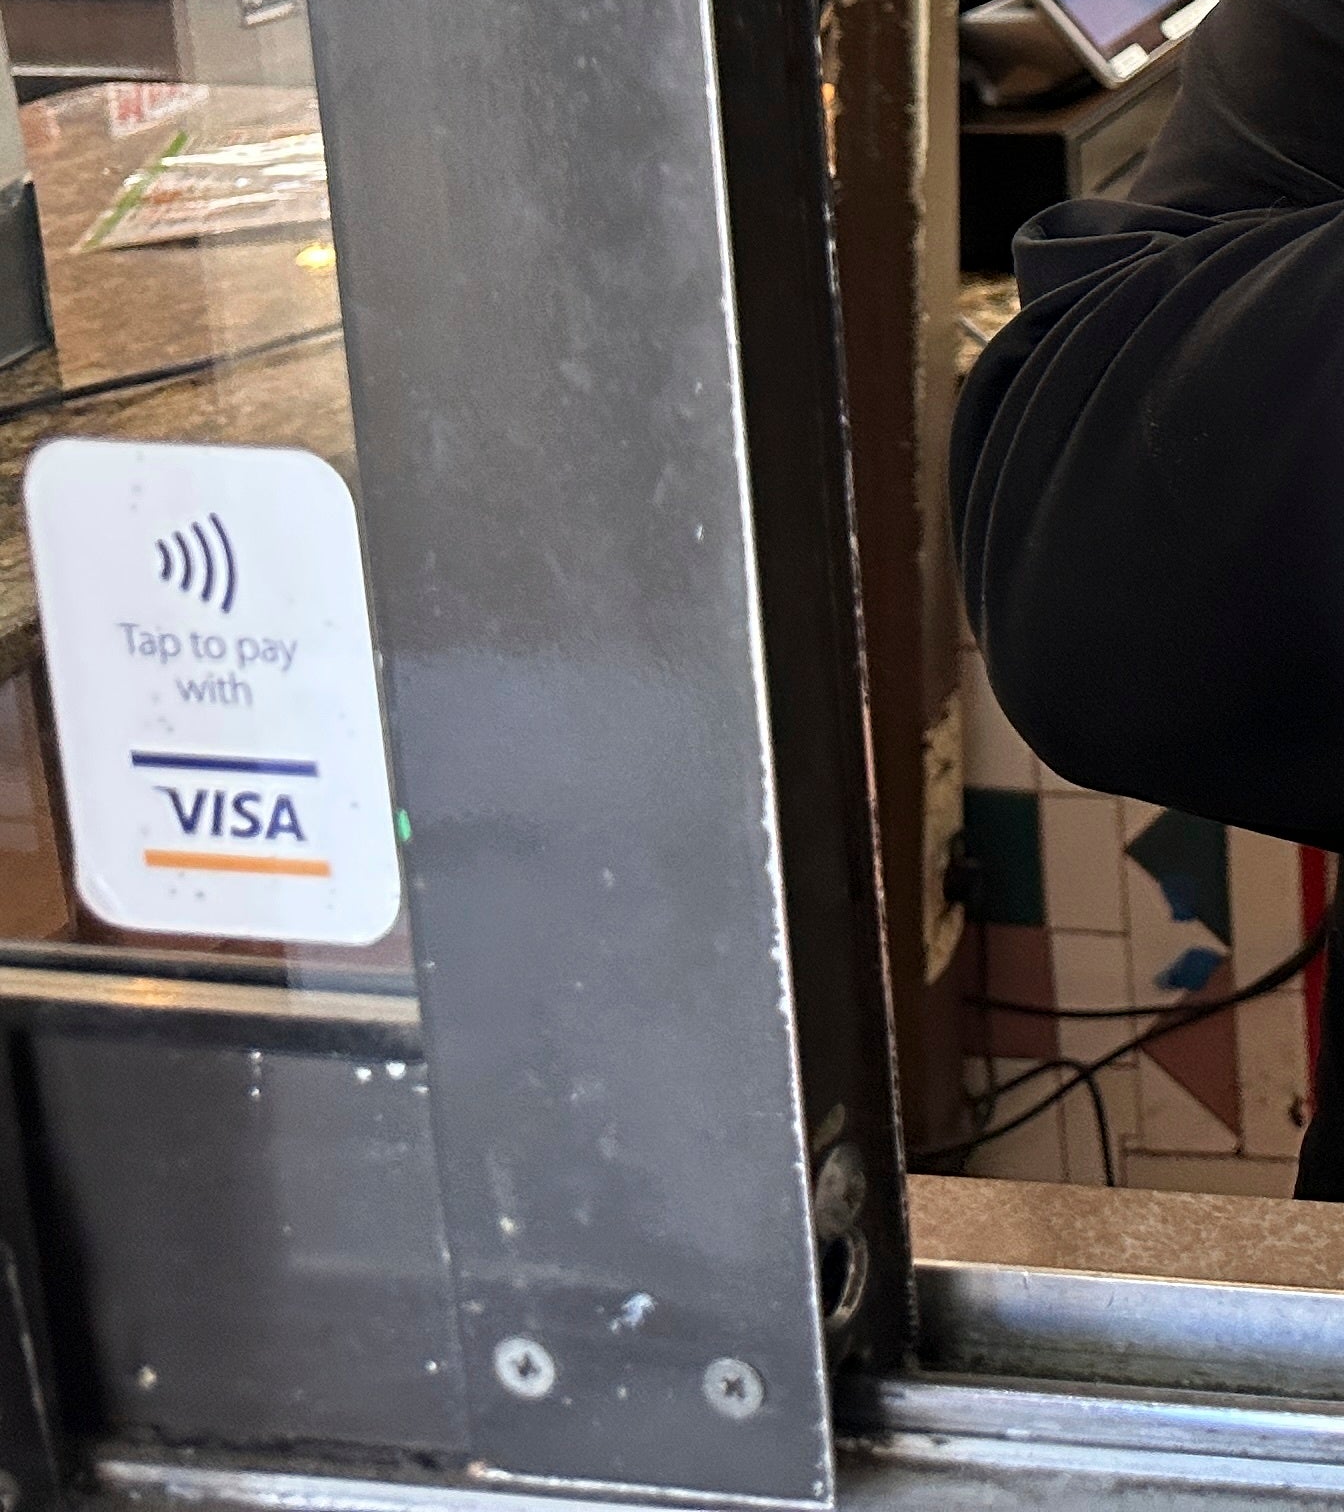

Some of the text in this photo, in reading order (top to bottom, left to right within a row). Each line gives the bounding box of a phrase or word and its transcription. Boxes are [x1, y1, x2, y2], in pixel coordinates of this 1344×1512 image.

[117, 621, 298, 672] Tap to pay
[174, 672, 253, 707] with
[154, 785, 308, 842] VISA
